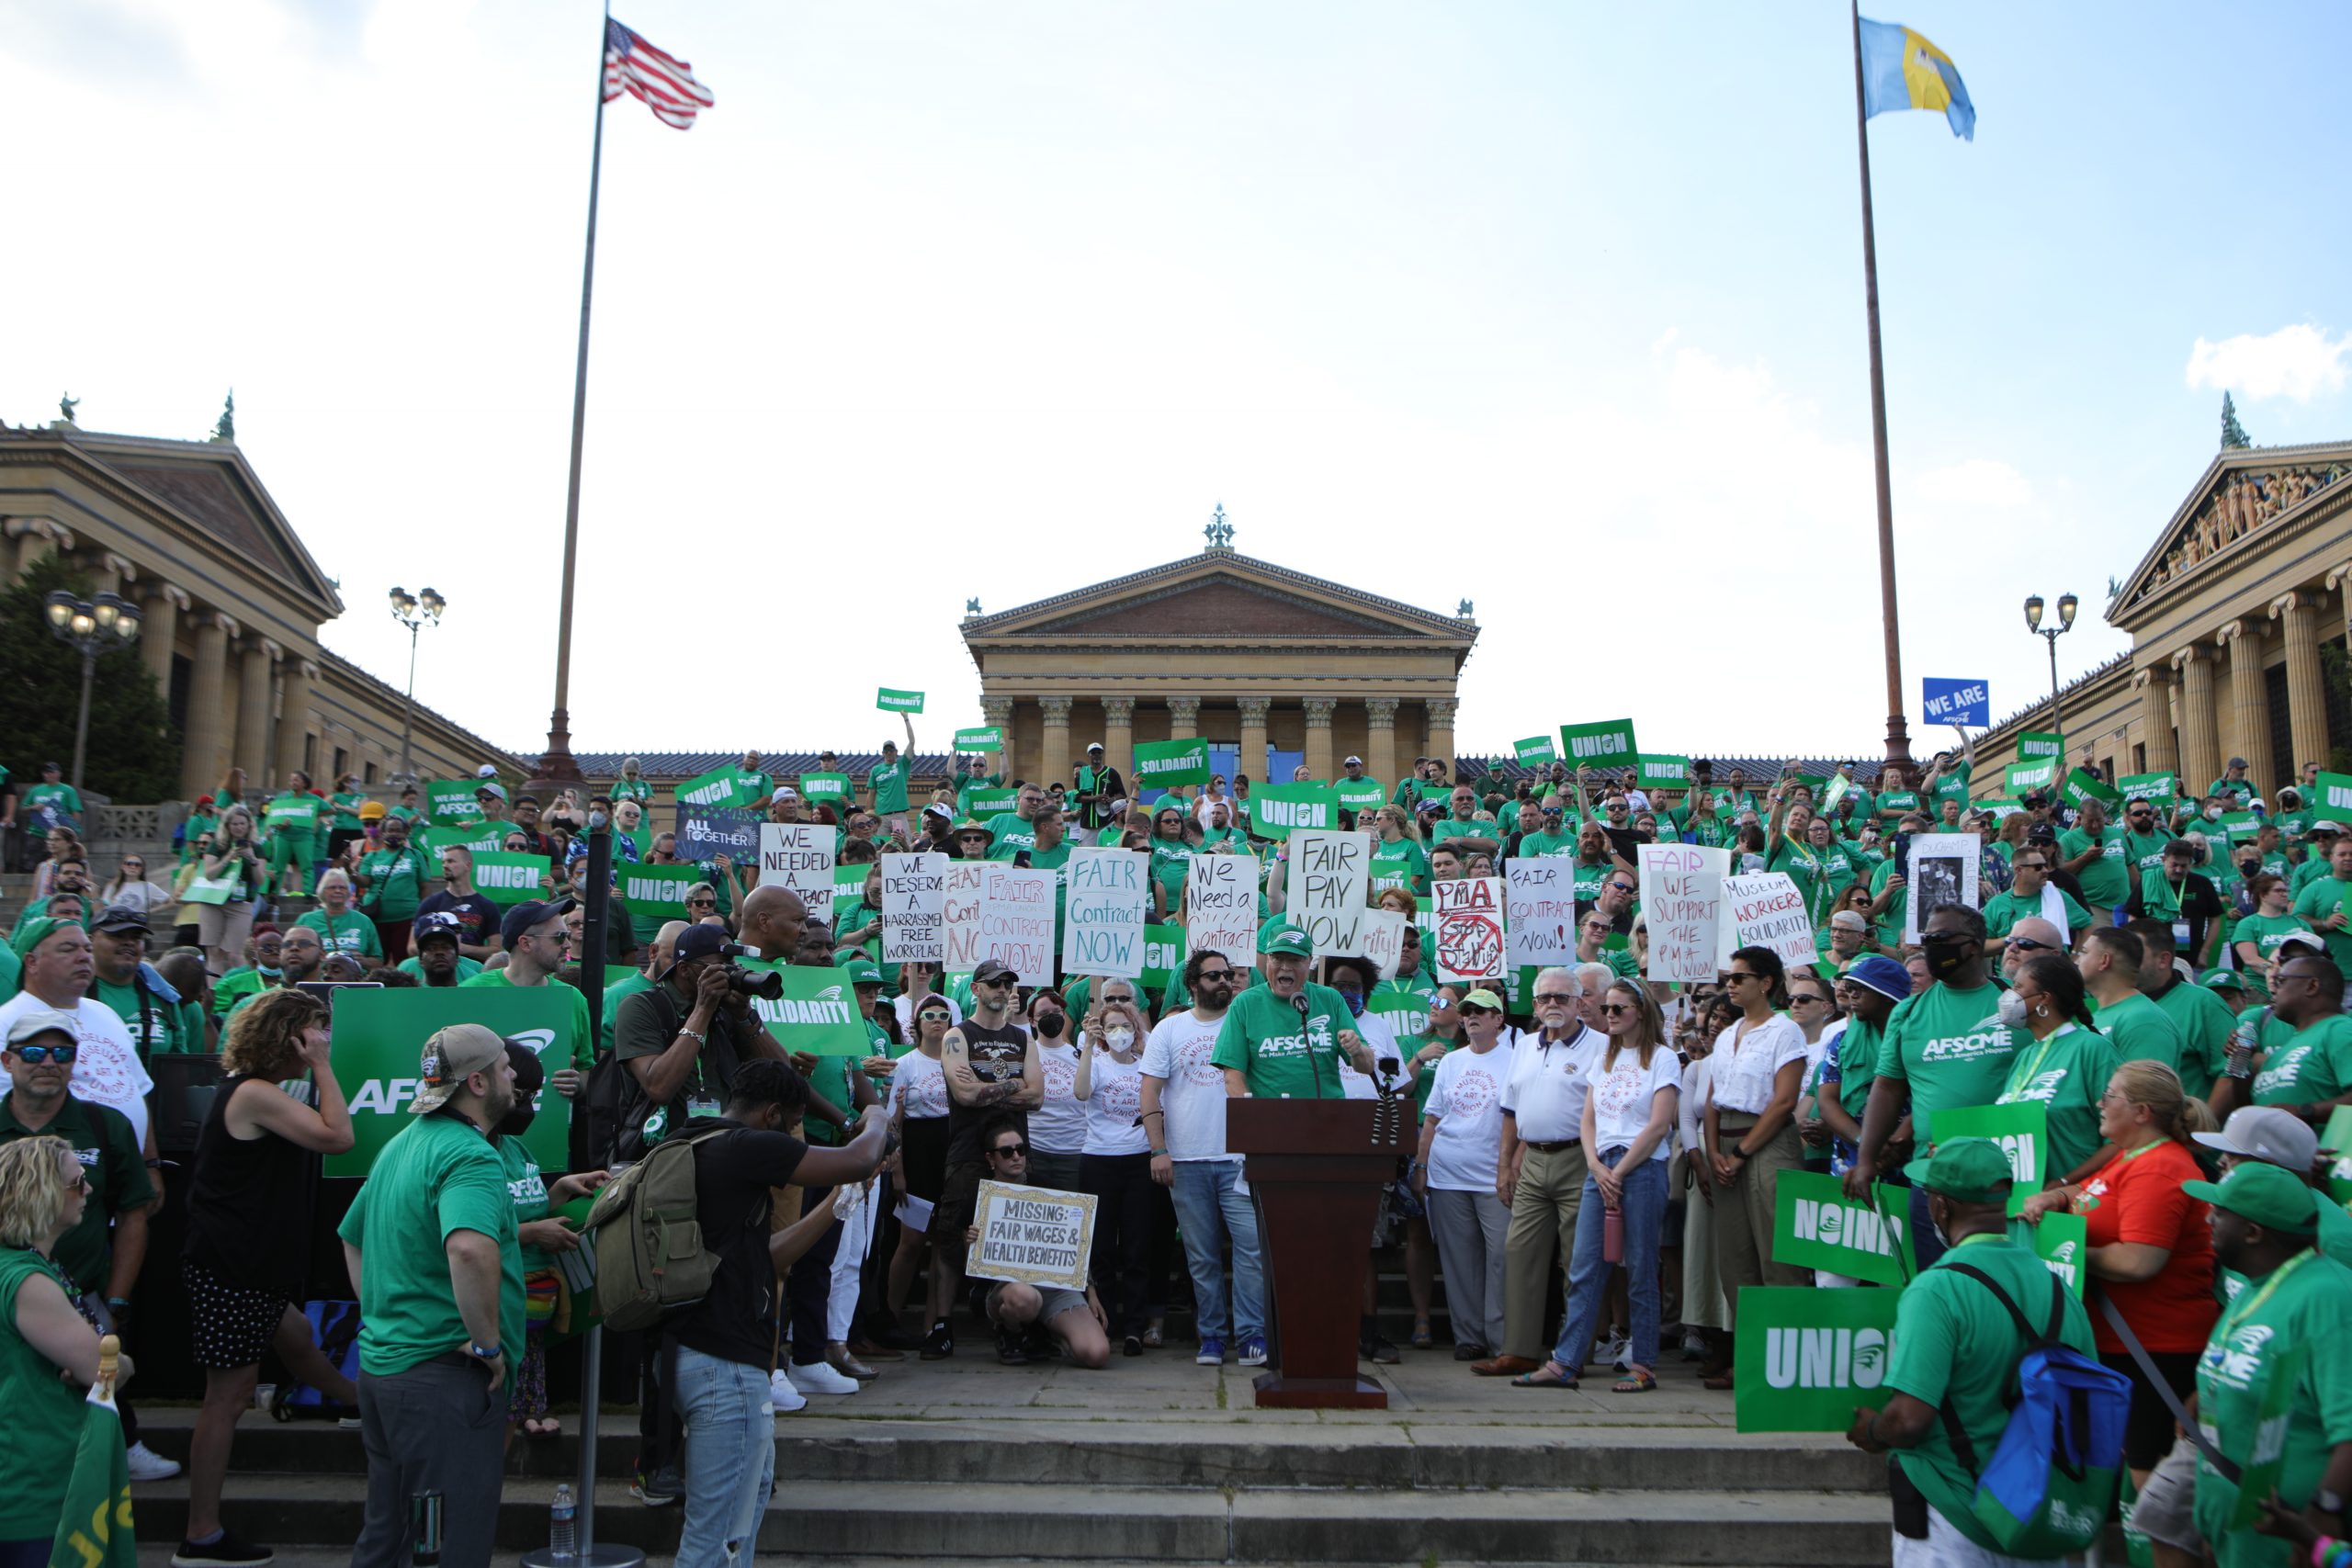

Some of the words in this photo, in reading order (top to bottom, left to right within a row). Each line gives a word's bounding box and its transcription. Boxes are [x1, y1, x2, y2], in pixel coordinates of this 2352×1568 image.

[879, 695, 922, 706] SOLIDARITY
[1925, 697, 1953, 716] WE
[1953, 684, 1986, 709] ARE
[957, 735, 999, 744] SOLIDARITY
[1570, 732, 1628, 758] UNION
[2024, 740, 2060, 755] UNION
[1519, 745, 1553, 759] SOLIDARITY
[1141, 754, 1204, 774] SOLIDARITY
[1645, 762, 1684, 779] UNION
[2012, 765, 2051, 786] UNION
[684, 778, 733, 806] UNION
[806, 780, 842, 794] UNION
[434, 795, 449, 803] WE
[973, 800, 1016, 811] SOLIDARITY
[1340, 793, 1382, 803] SOLIDARITY
[435, 802, 481, 816] AFSC
[1261, 798, 1326, 827] UNION
[685, 819, 710, 832] ALL
[685, 829, 748, 847] TOGETHER
[778, 827, 812, 848] WE
[764, 851, 831, 871] NEEDED
[900, 856, 926, 873] WE
[1302, 837, 1358, 874] FAIR
[476, 864, 539, 889] UNION
[785, 872, 797, 887] A
[1073, 858, 1137, 890] FAIR
[1195, 856, 1237, 886] We
[1510, 869, 1557, 889] FAIR
[627, 876, 689, 903] UNION
[885, 876, 943, 894] DESERVE
[989, 874, 1045, 904] FAIR
[1306, 874, 1353, 909] PAY
[1663, 876, 1701, 897] WE
[1725, 879, 1792, 899] MUSEUM
[908, 895, 921, 910] A
[1190, 886, 1233, 911] Need
[1238, 892, 1253, 911] a
[1735, 891, 1803, 922] WORKERS
[885, 912, 944, 928] HARRASSME
[1070, 897, 1142, 925] Contract
[1510, 900, 1575, 919] CONTRACT
[1655, 897, 1719, 923] SUPPORT
[900, 928, 934, 942] FREE
[982, 913, 1055, 938] CONTRACT
[1295, 912, 1359, 951] NOW
[1668, 925, 1702, 943] THE
[1741, 914, 1807, 945] SOLIDARITY
[1074, 930, 1136, 965] NOW
[1519, 924, 1566, 953] NOW!
[885, 943, 943, 960] WORKPLACE
[989, 942, 1045, 975] NOW
[1659, 947, 1701, 964] PMA
[1181, 1035, 1217, 1056] PHILADE
[1189, 1043, 1216, 1057] MUSE
[1258, 1032, 1332, 1053] AFSCME
[1922, 1031, 2012, 1056] AFSCME
[1044, 1087, 1069, 1096] NION
[1103, 1075, 1143, 1094] PHILADEL
[1113, 1083, 1141, 1097] MUSEU
[1003, 1200, 1069, 1223] MISSING:
[989, 1221, 1022, 1241] FAIR
[1024, 1224, 1067, 1246] WAGES
[1069, 1228, 1079, 1247] &
[983, 1241, 1027, 1264] HEALTH
[1026, 1247, 1077, 1268] BENEFITS
[1764, 1327, 1894, 1389] UNIO
